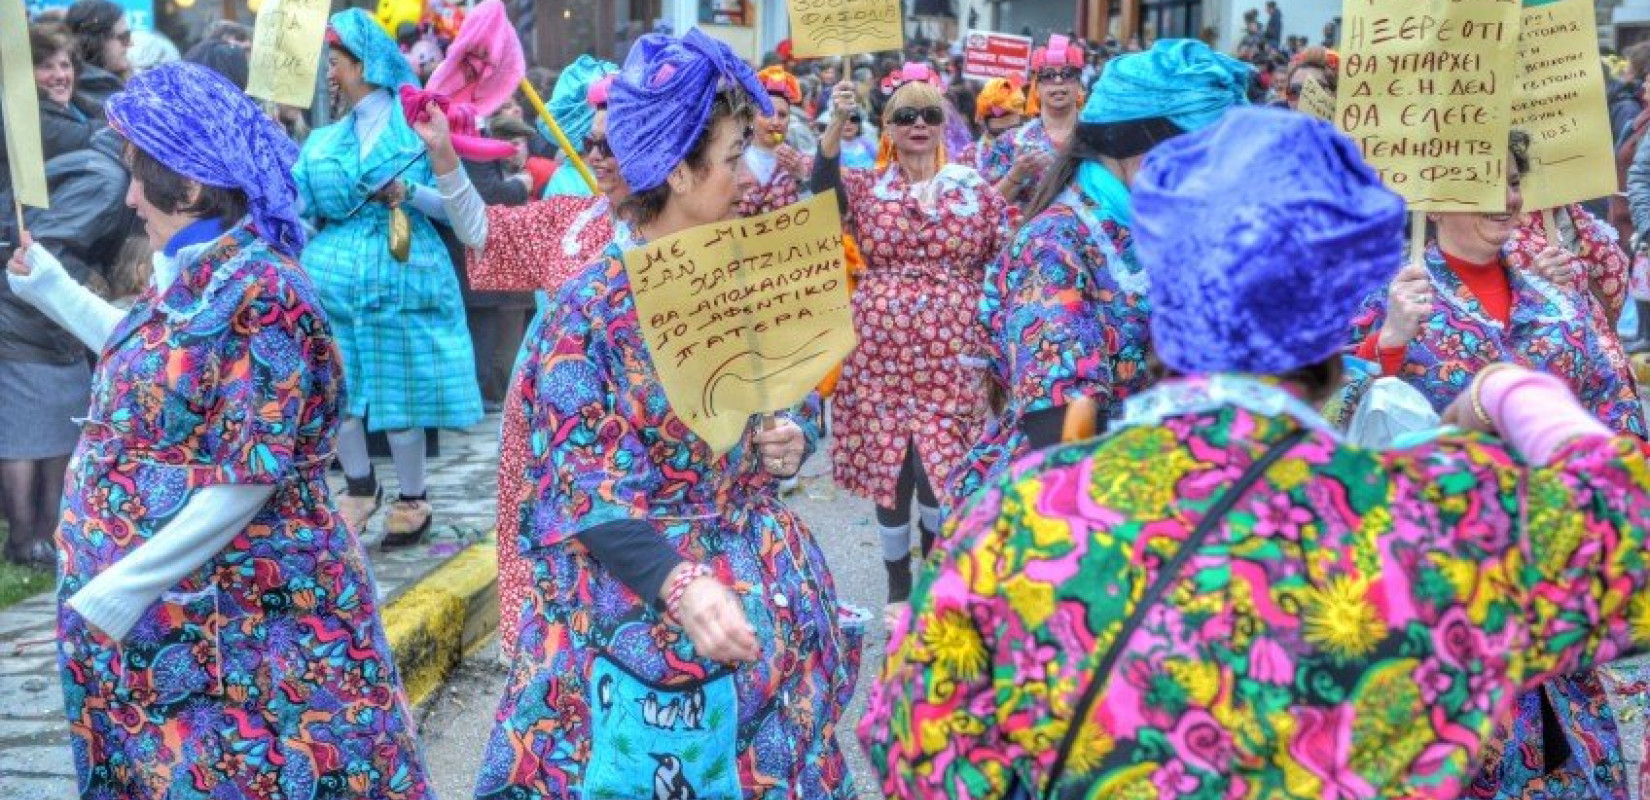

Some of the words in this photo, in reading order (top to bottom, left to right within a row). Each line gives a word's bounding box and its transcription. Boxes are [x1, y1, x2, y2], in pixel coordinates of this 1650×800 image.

[1463, 20, 1503, 41] ΟΤΙ
[1346, 53, 1378, 78] ΘΑ
[1387, 51, 1480, 74] ΥΠΑΡΧΕΙ
[1450, 70, 1495, 96] ΔΕΝ
[1343, 104, 1379, 132] ΘΑ
[1379, 168, 1407, 184] ΤΟ
[638, 239, 686, 274] ΜΕ
[704, 208, 810, 247] ΜΙΣΘΟ
[651, 311, 680, 329] ΘΑ
[689, 259, 841, 316] ΑΠΟΚΑΛΟΥΜΕ
[657, 324, 688, 351] ΤΟ
[697, 279, 838, 331] ΑΦΕΝΤΙΚΟ
